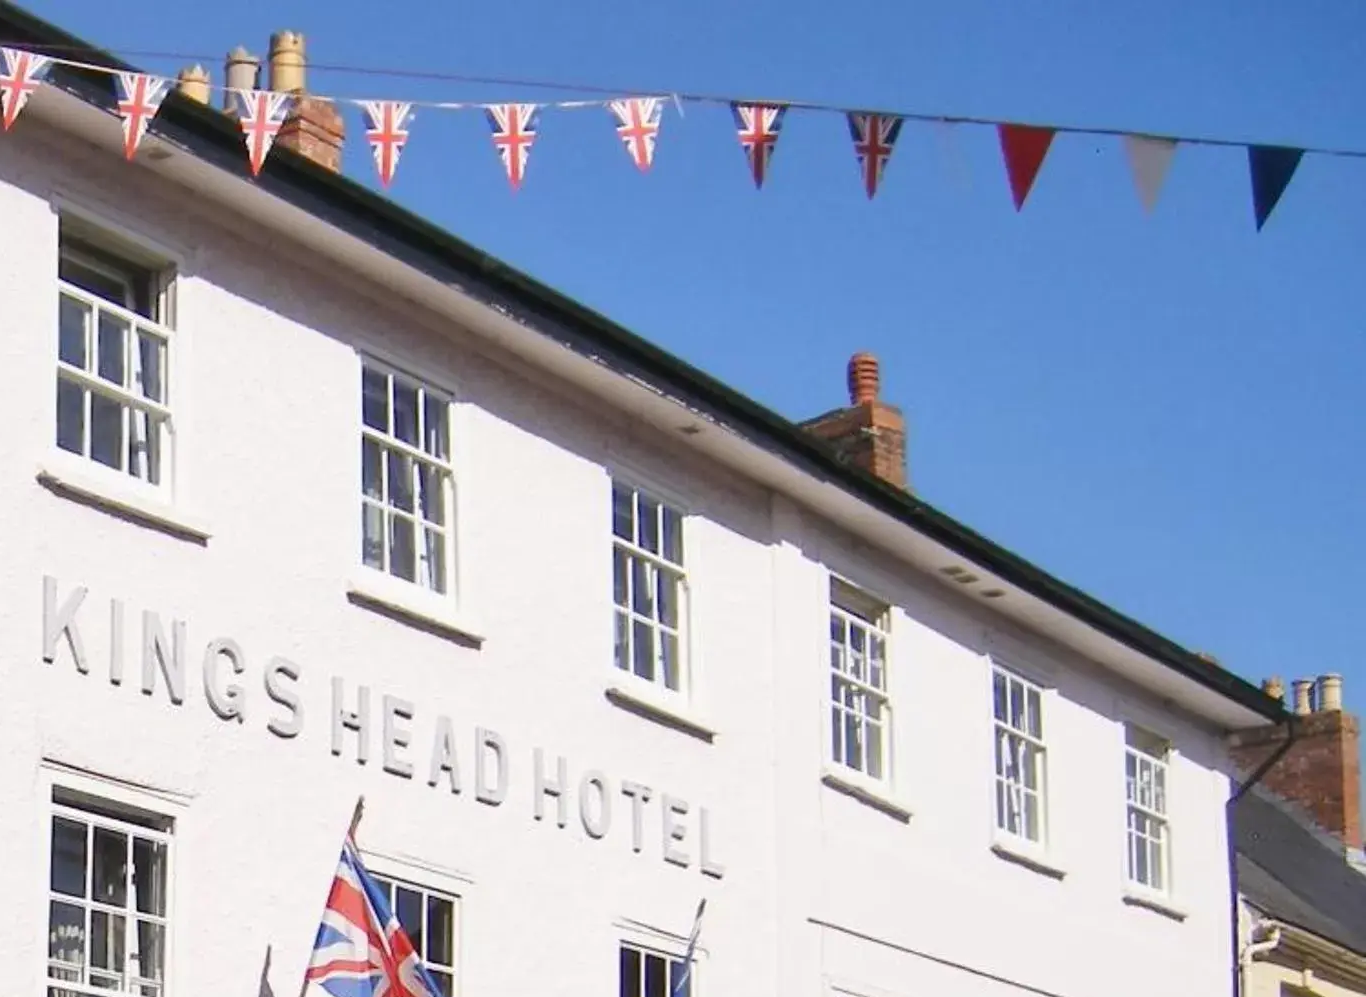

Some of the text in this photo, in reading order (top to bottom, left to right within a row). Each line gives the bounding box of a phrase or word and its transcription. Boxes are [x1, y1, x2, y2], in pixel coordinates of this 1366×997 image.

[42, 575, 727, 880] KINGS HEAD HOTEL
